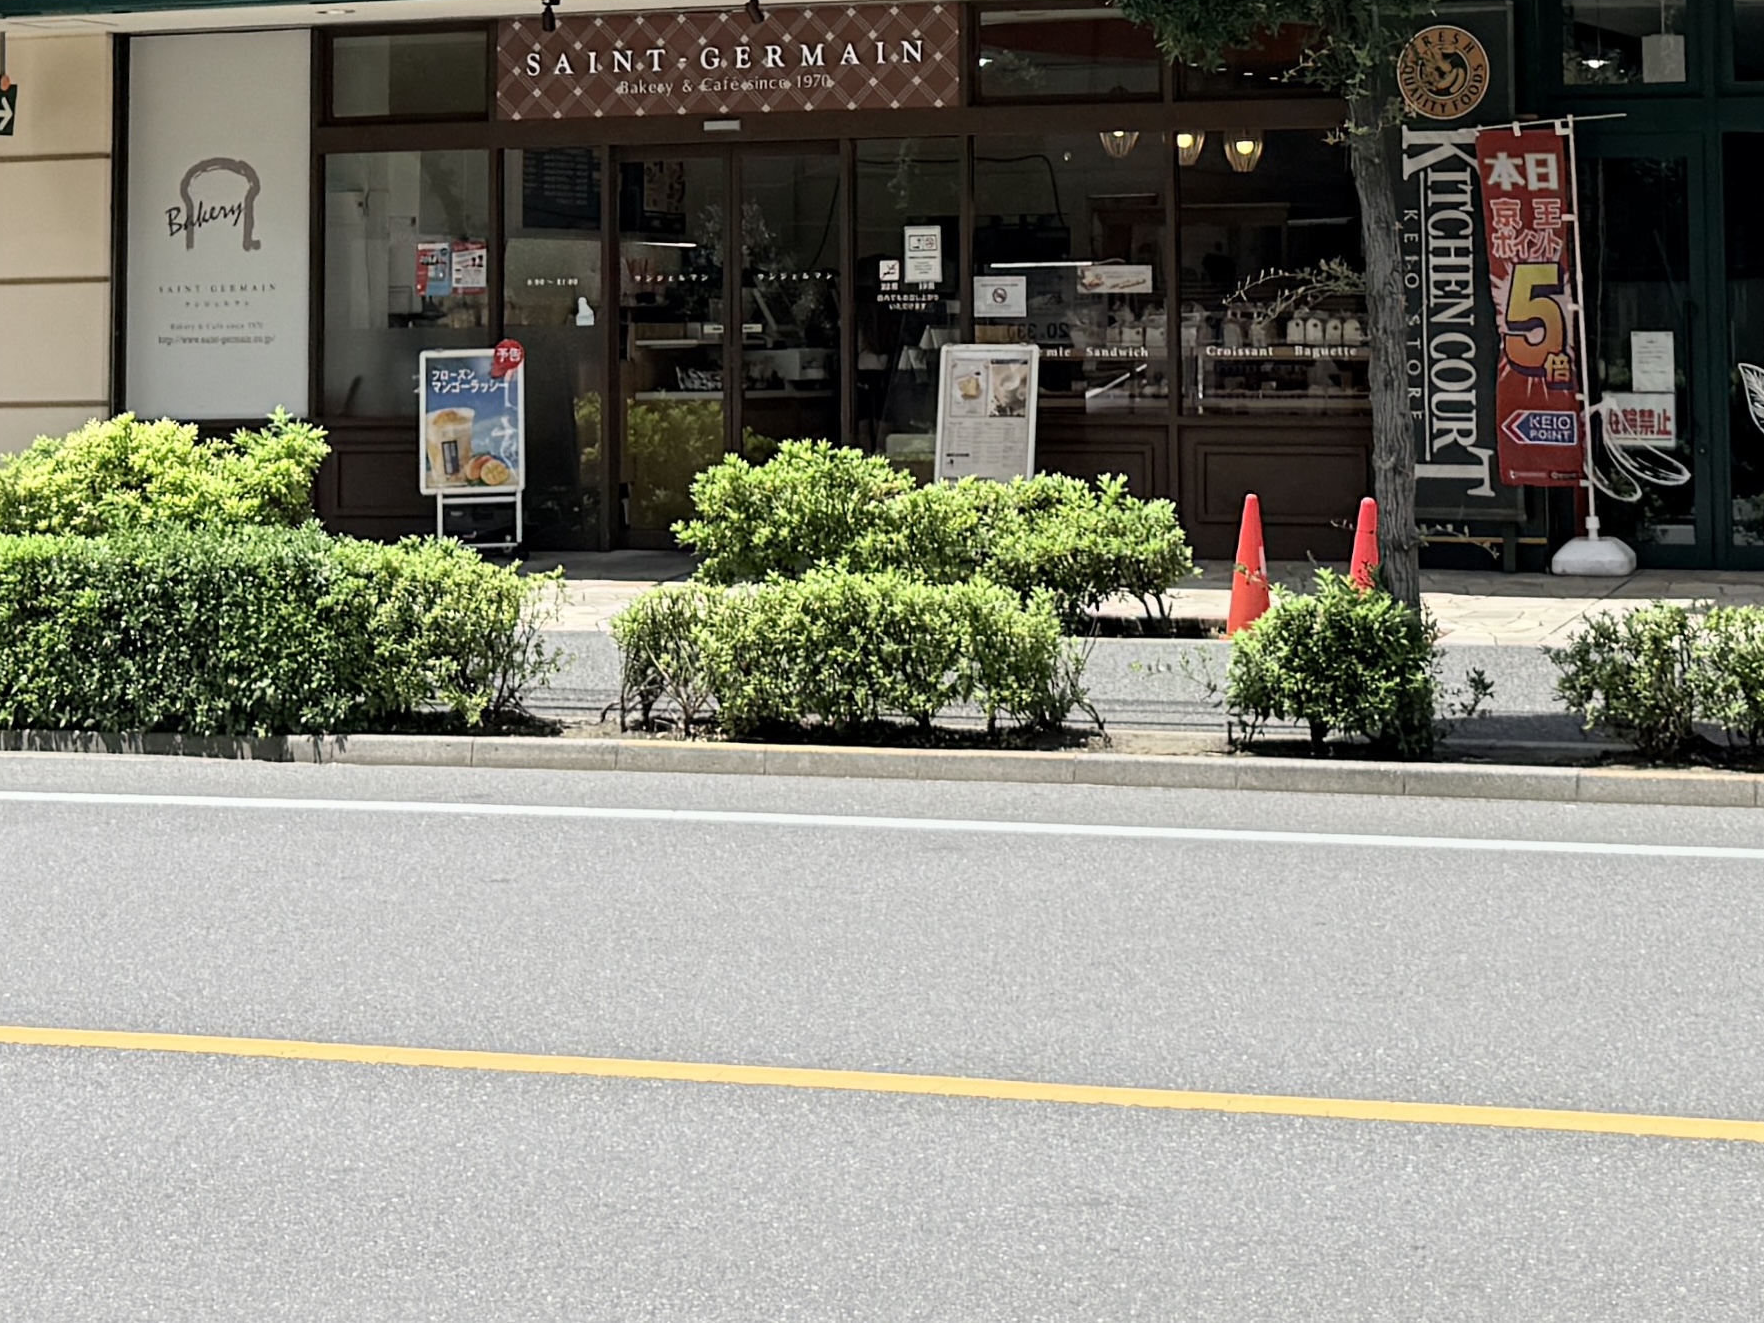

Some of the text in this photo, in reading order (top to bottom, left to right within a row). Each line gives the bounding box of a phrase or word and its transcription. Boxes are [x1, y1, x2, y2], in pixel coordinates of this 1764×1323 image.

[620, 80, 673, 97] Bakery
[796, 72, 831, 89] 1970
[1402, 63, 1484, 113] QUALITY FOODS
[1484, 152, 1559, 191] 本日
[165, 200, 244, 237] Bakery
[1490, 198, 1561, 229] 京王
[1492, 229, 1562, 259] ポイント
[1085, 346, 1149, 358] Sandwich
[1205, 345, 1358, 360] Croissant Baguette
[432, 369, 476, 381] フローズン
[1414, 333, 1496, 498] COURT
[1529, 415, 1570, 429] KEIO
[1530, 429, 1571, 442] POINT
